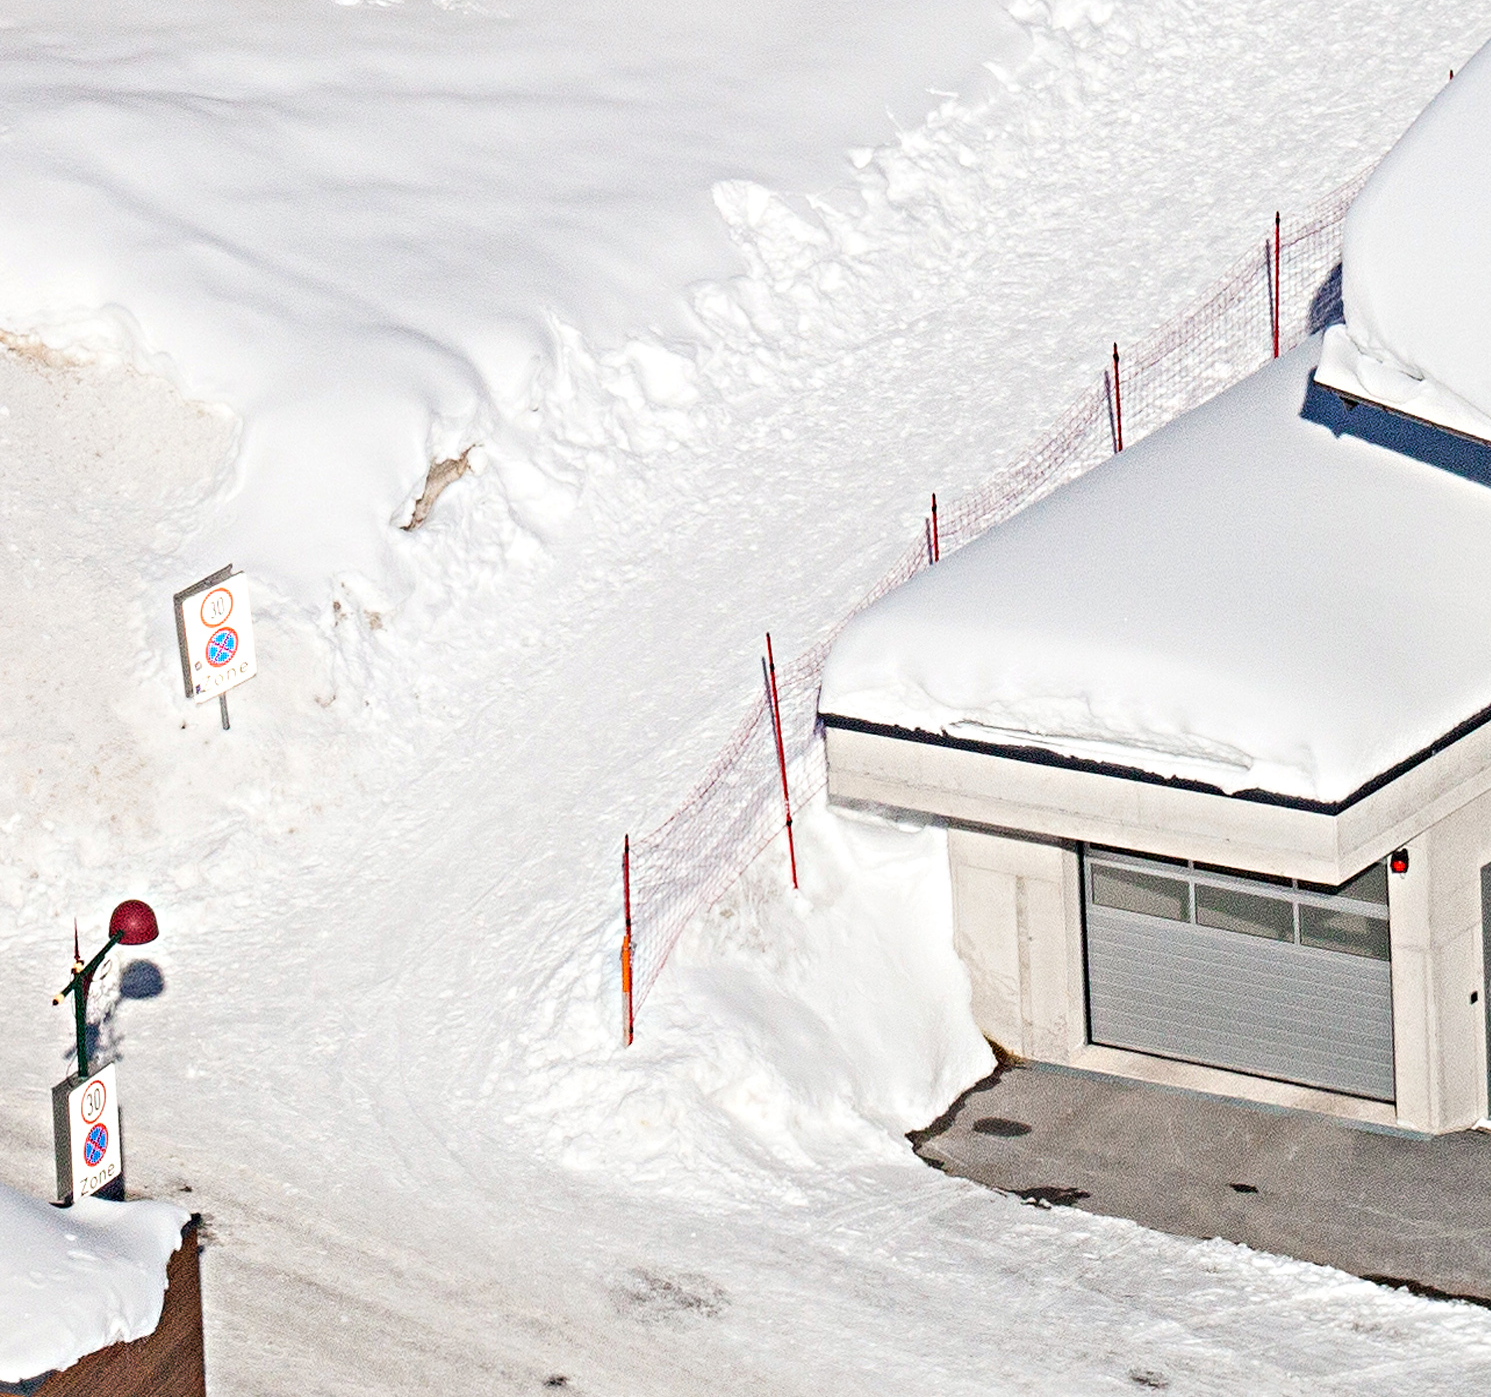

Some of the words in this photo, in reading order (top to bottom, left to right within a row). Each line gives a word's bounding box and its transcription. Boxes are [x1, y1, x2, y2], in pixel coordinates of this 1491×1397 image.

[210, 596, 225, 619] 30
[87, 1088, 101, 1117] 30
[79, 1163, 116, 1196] Zone
